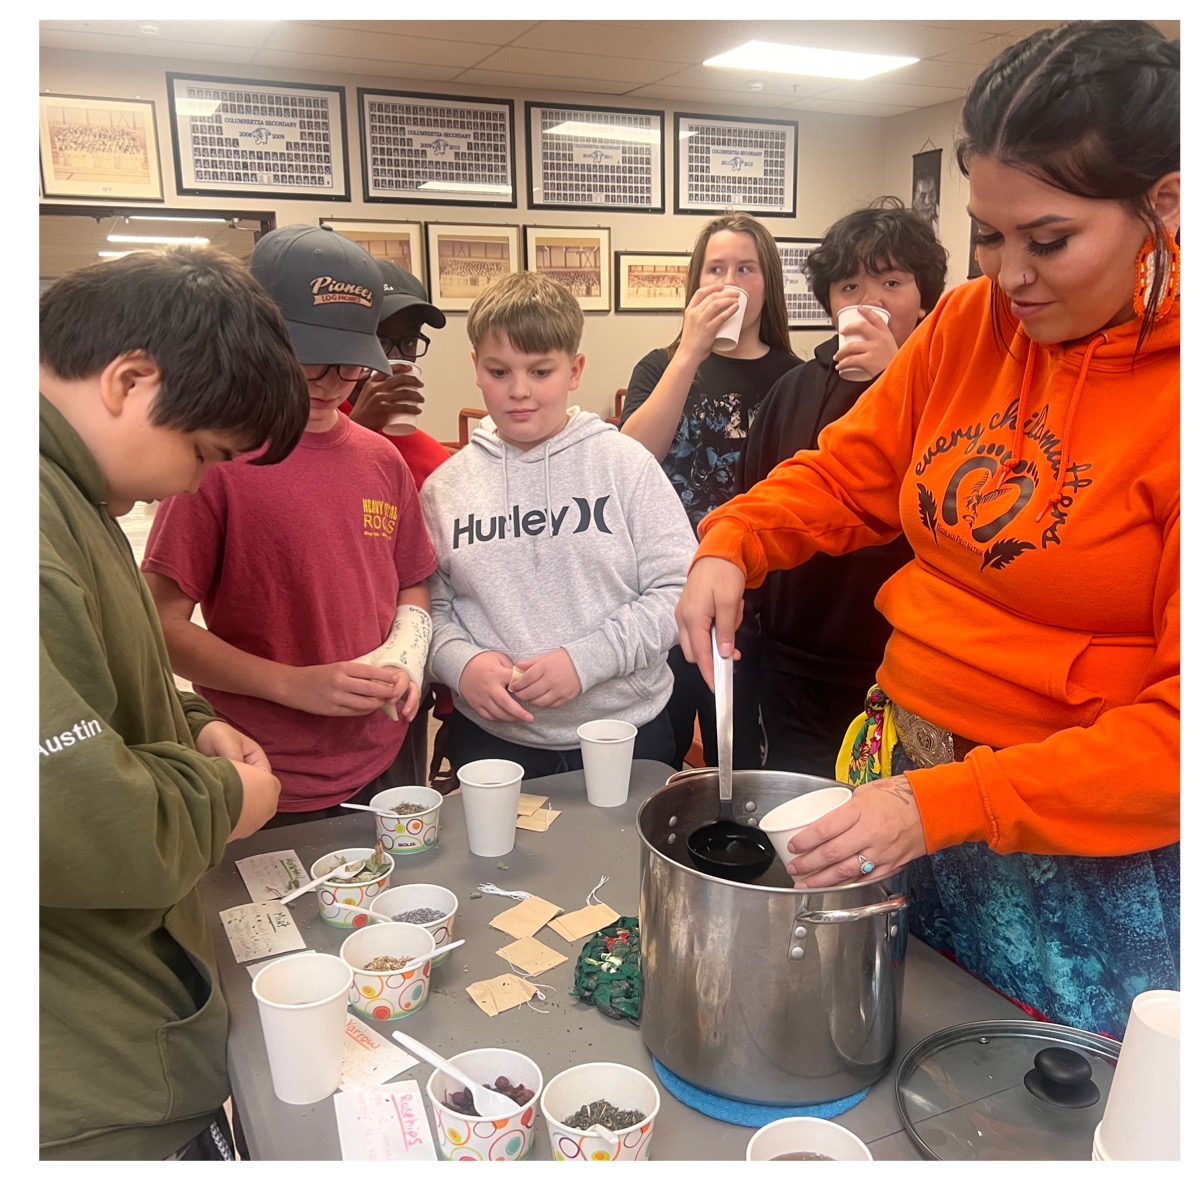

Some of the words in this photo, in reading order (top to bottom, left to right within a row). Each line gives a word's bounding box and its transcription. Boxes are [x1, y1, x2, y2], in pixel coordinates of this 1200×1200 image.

[309, 276, 373, 299] Pioneer
[914, 422, 985, 476] every
[364, 514, 396, 534] ROCS
[453, 504, 569, 550] Hurley
[345, 1019, 381, 1049] Yarrow
[399, 1093, 423, 1148] Rosehips
